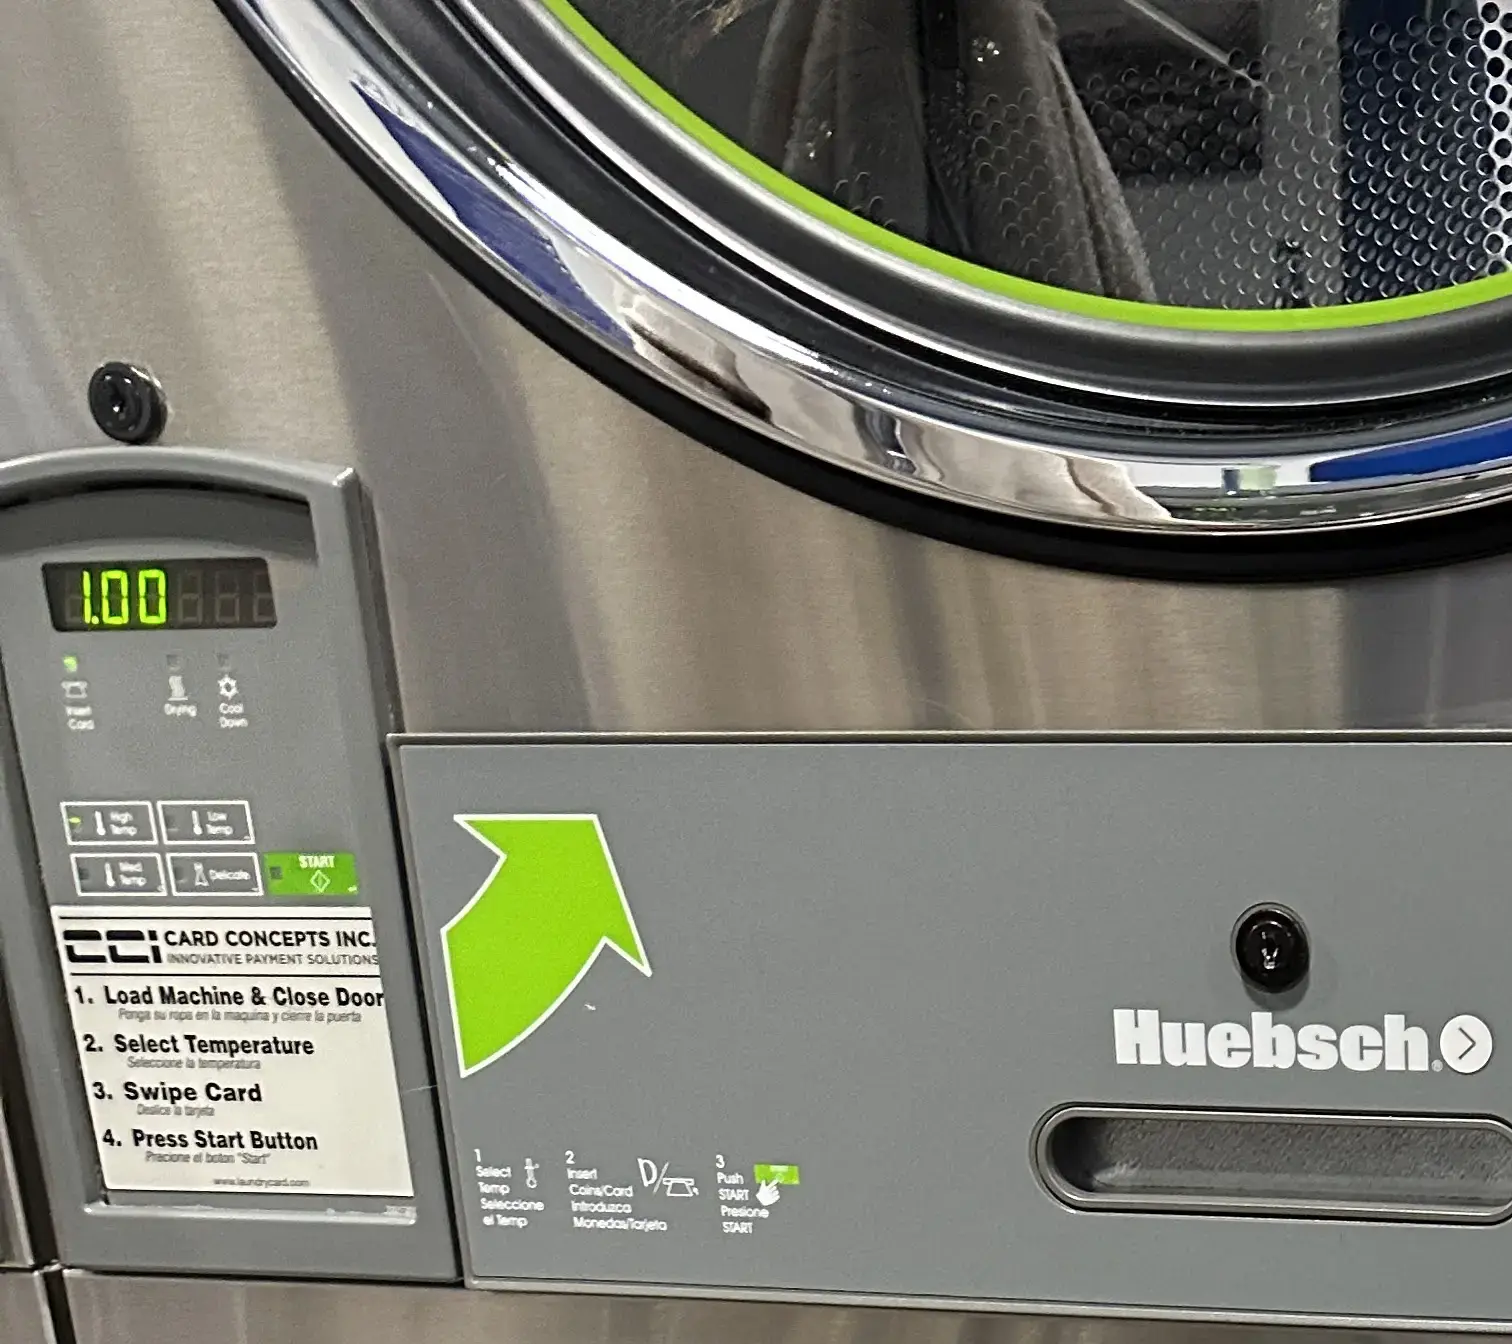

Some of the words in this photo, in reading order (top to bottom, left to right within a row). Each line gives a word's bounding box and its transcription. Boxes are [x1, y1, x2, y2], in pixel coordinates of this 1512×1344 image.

[83, 568, 167, 626] 1.00
[299, 855, 335, 868] START
[164, 930, 219, 946] CARD
[225, 930, 330, 947] CONCEPTS
[337, 931, 377, 947] INC.
[167, 953, 243, 965] INNOVATIVE
[246, 953, 303, 965] PAYMENT
[307, 954, 379, 966] SOLUTIONS
[74, 985, 94, 1004] 1.
[104, 985, 154, 1005] Load
[158, 985, 244, 1006] Machine
[251, 986, 267, 1006] &
[273, 986, 330, 1006] Close
[335, 987, 385, 1007] Door
[83, 1033, 104, 1052] 2.
[114, 1033, 179, 1053] Select
[184, 1033, 315, 1058] Temperature
[92, 1081, 113, 1100] 3.
[124, 1081, 197, 1104] Swipe
[205, 1082, 263, 1102] Card
[103, 1129, 122, 1147] 4.
[132, 1128, 188, 1148] Press
[194, 1130, 245, 1149] Start
[250, 1130, 318, 1150] Button
[474, 1148, 481, 1162] 1
[564, 1150, 575, 1164] 2
[715, 1154, 725, 1169] 3
[476, 1165, 512, 1178] Select
[717, 1172, 744, 1185] Push
[718, 1187, 749, 1201] START
[720, 1205, 769, 1219] Presione
[722, 1221, 753, 1234] START
